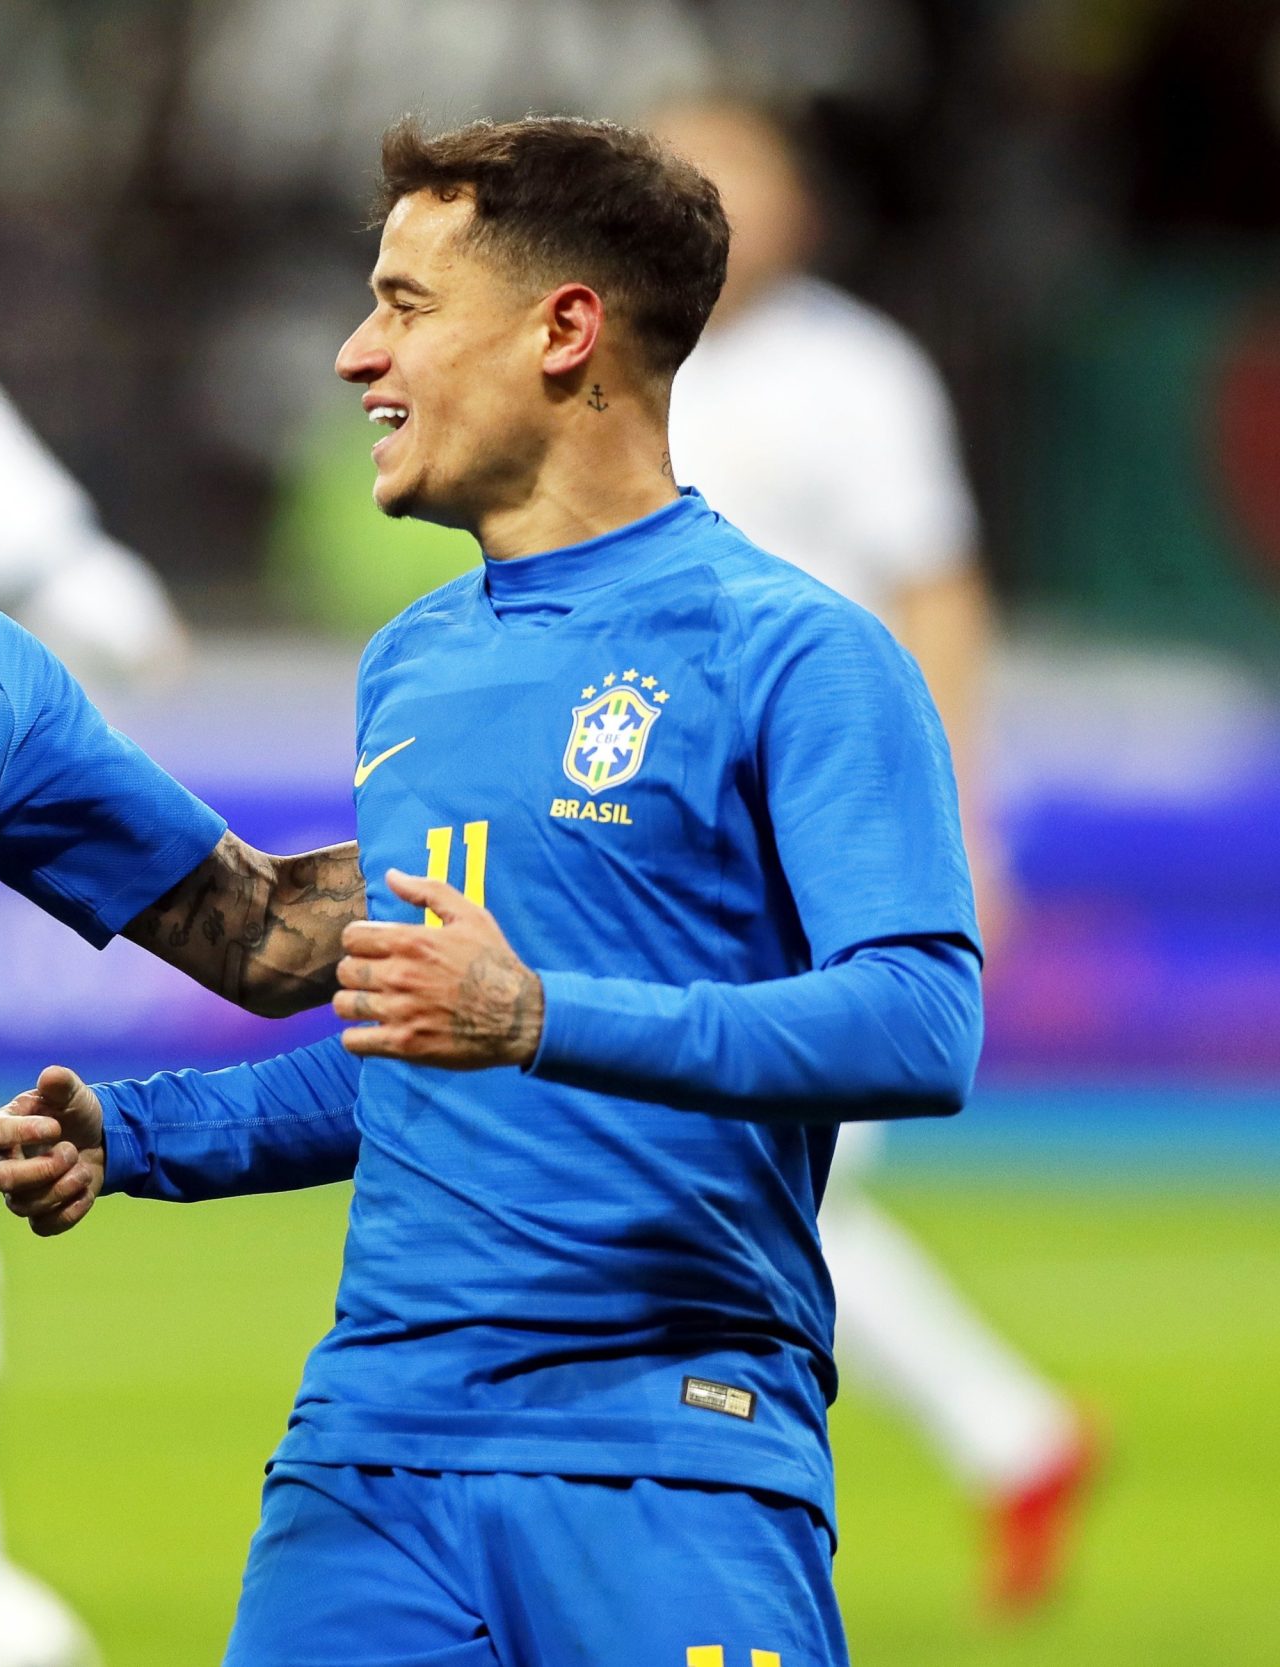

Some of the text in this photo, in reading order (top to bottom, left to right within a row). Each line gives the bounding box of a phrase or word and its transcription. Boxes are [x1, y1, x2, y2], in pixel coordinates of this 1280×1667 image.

[595, 732, 621, 744] CBF
[549, 798, 633, 825] BRASIL
[424, 820, 489, 928] 11
